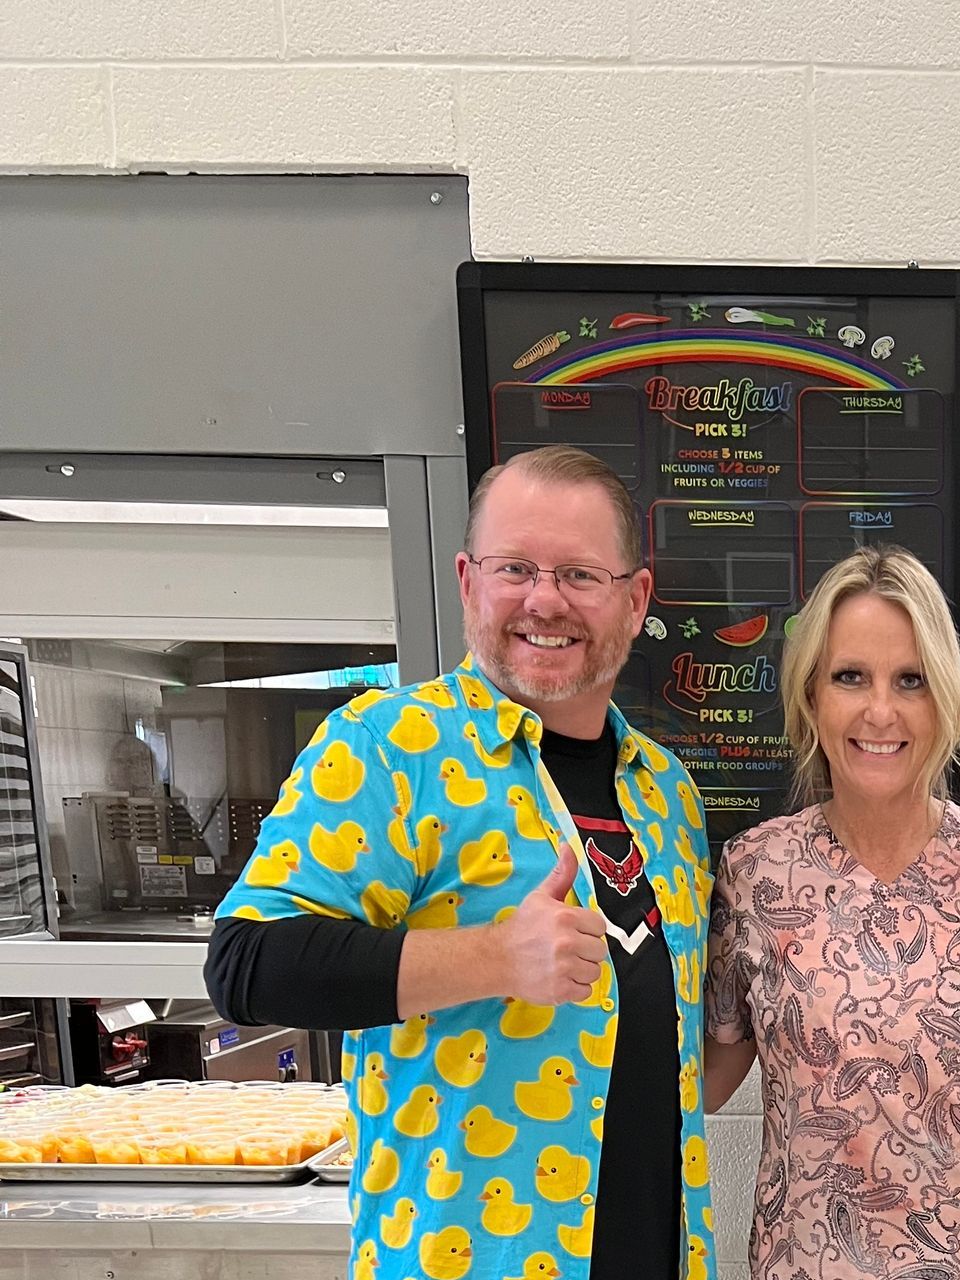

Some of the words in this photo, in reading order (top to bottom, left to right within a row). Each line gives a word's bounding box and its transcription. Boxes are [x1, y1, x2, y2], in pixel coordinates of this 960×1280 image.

[541, 391, 591, 406] MONDAY
[645, 376, 792, 420] Breakfast
[842, 396, 902, 410] THURSDAY
[695, 423, 728, 437] PICK
[678, 449, 719, 459] CHOOSE
[734, 450, 763, 460] ITEMS
[661, 463, 715, 473] INCLUDING
[718, 461, 744, 474] 1/2
[745, 465, 766, 474] CUP
[767, 465, 781, 474] OF
[674, 478, 707, 487] FRUITS
[710, 478, 725, 488] OR
[727, 478, 769, 488] VEGGIES
[688, 509, 755, 523] WEDNESDAY
[849, 511, 893, 524] FRIDAY
[672, 652, 777, 703] Lunch
[700, 708, 734, 723] PICK
[659, 734, 698, 744] CHOOSE
[700, 732, 725, 744] 1/2
[725, 735, 745, 744] CUP
[746, 735, 760, 745] OF
[679, 747, 718, 757] VEGGIES
[720, 744, 751, 757] PLUS
[752, 748, 765, 758] AT
[766, 749, 794, 758] LEAST
[683, 761, 715, 770] OTHER
[716, 761, 744, 770] FOOD
[745, 762, 783, 771] GROUPS
[702, 795, 760, 808] EDNESDAY
